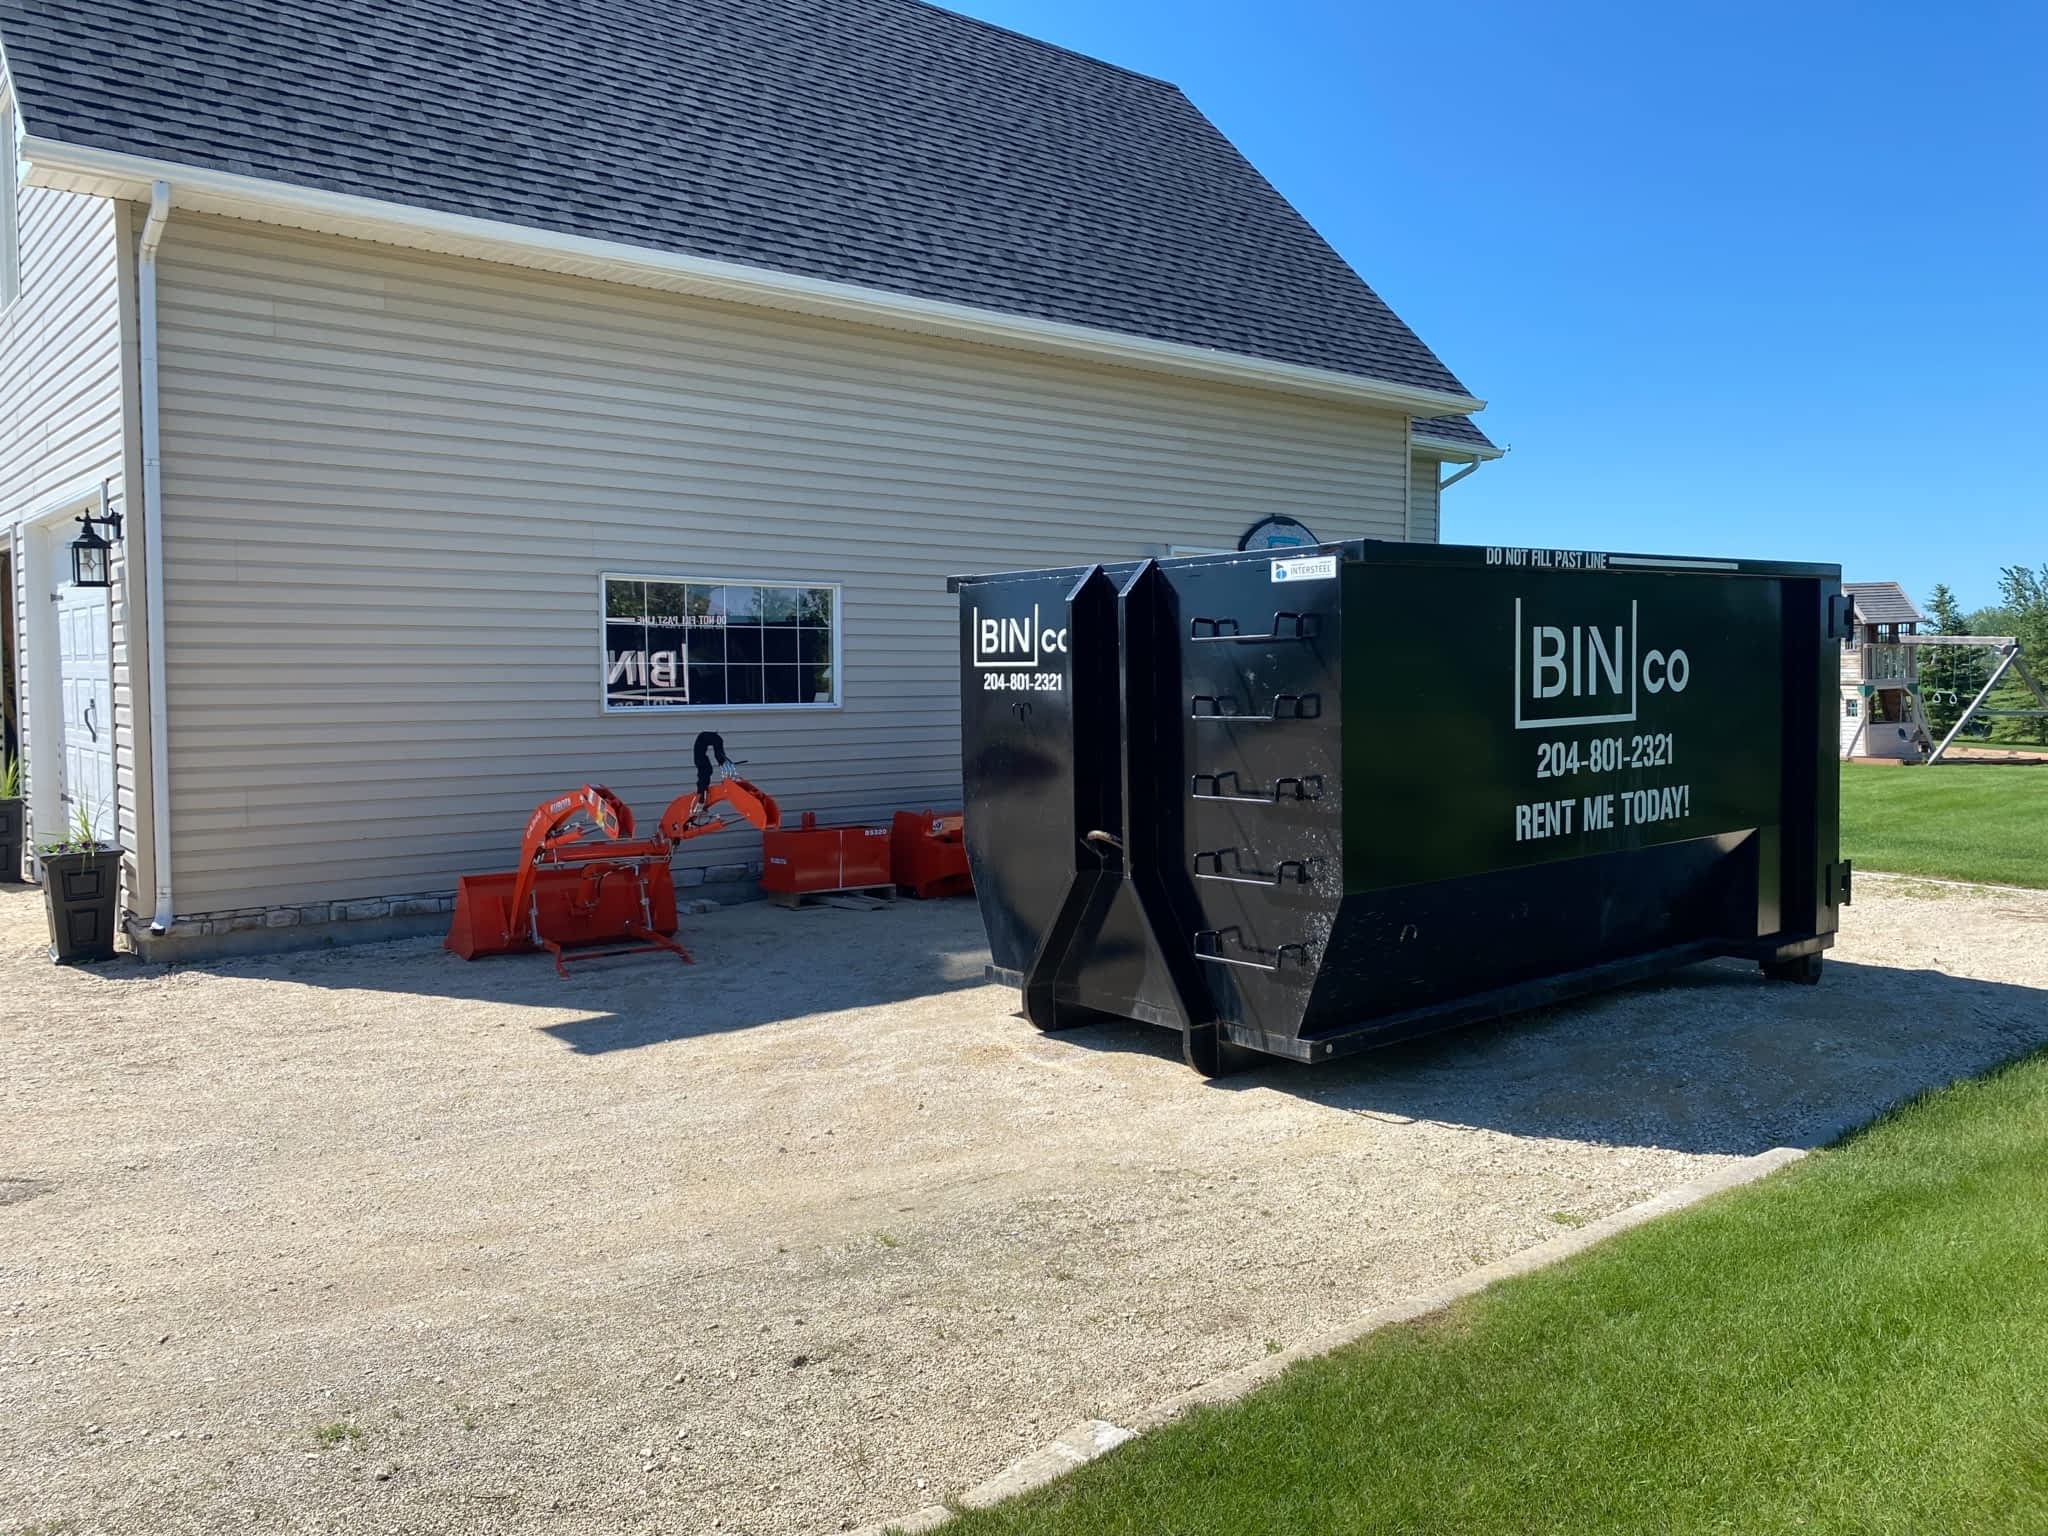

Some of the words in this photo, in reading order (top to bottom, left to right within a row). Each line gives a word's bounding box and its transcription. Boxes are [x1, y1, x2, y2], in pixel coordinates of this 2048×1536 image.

[1290, 564, 1331, 576] INTERSTEEL
[1486, 548, 1502, 565] DO
[1505, 548, 1529, 566] NOT
[1531, 550, 1552, 567] FILL
[1555, 551, 1583, 568] PAST
[1585, 552, 1607, 569] LINE
[981, 617, 1030, 653] BIN
[1533, 626, 1623, 698] BIN
[983, 673, 1062, 691] 204-801-2321
[1536, 733, 1673, 778] 204-801-2321
[1515, 799, 1576, 842] RENT
[1583, 794, 1615, 832] ME
[1621, 784, 1690, 826] TODAY!
